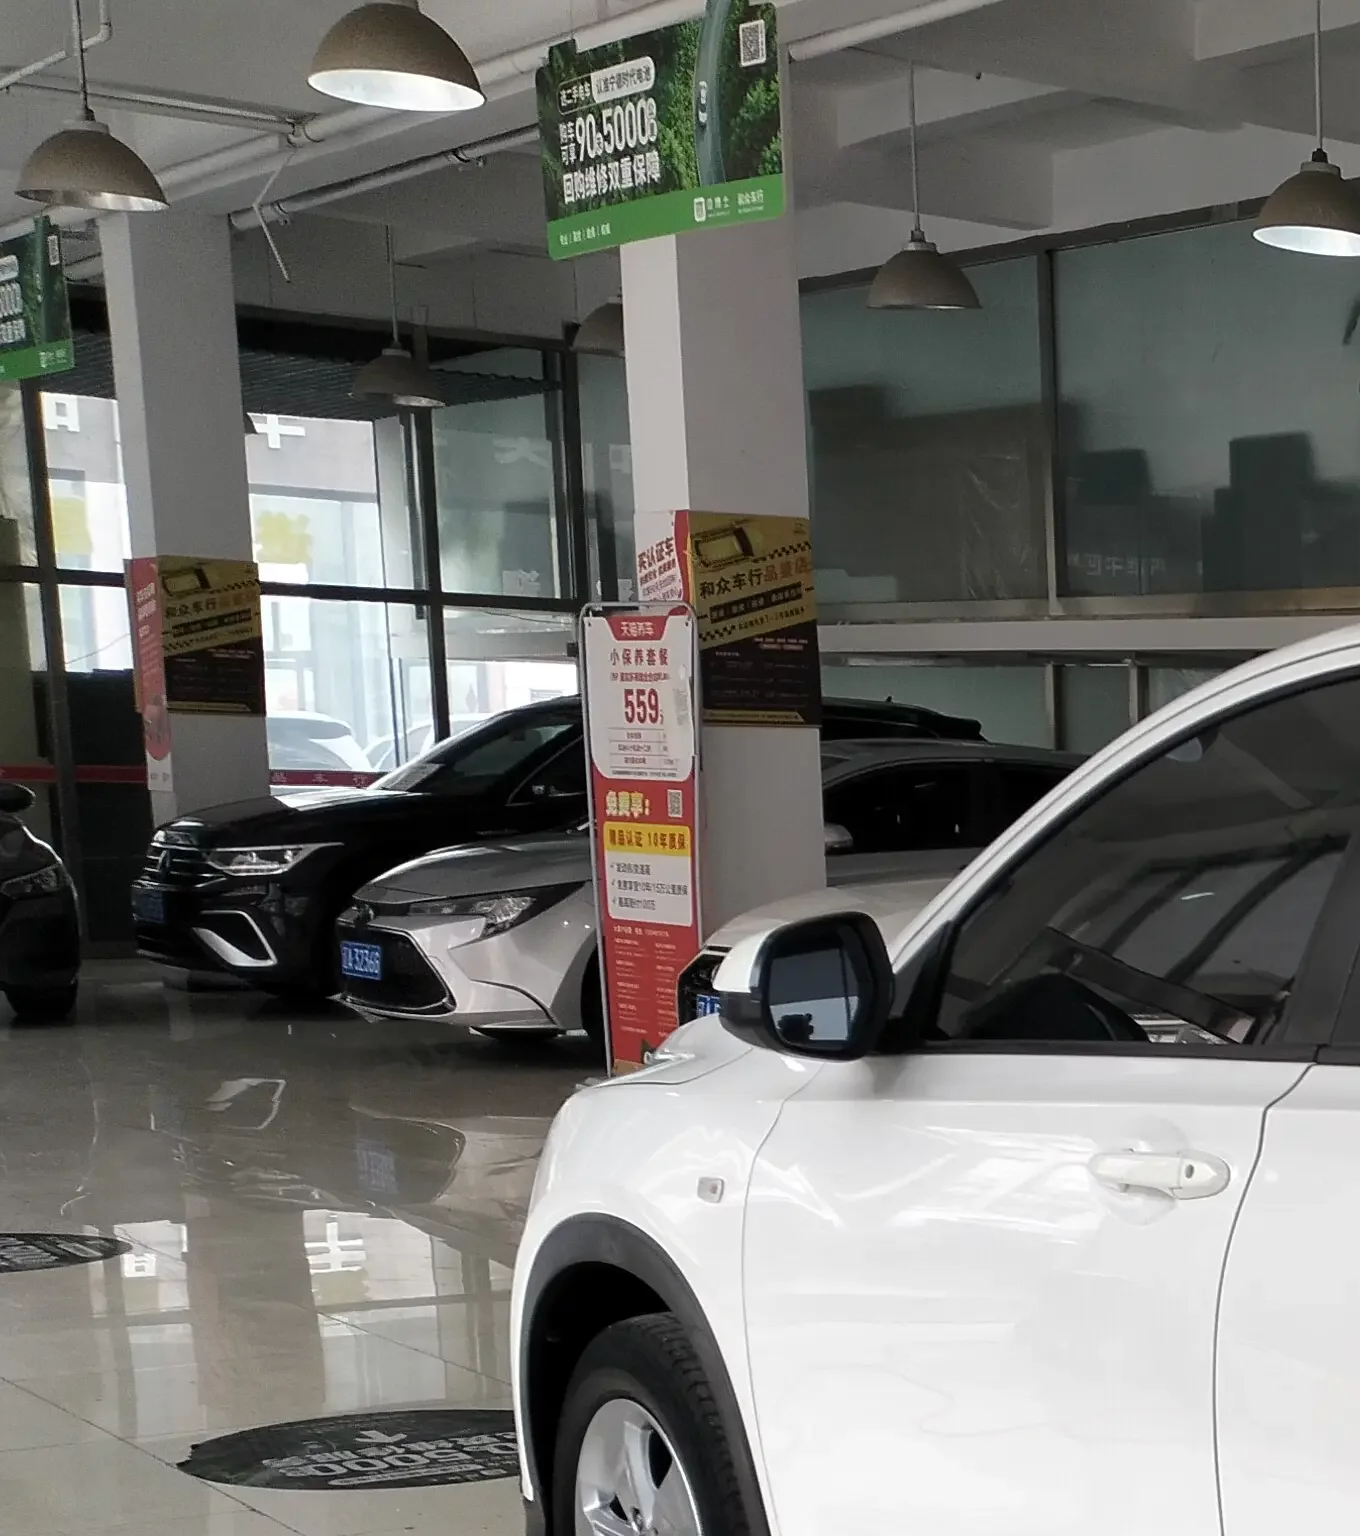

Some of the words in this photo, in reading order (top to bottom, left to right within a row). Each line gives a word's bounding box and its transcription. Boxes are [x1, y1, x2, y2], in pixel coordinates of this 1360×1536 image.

[609, 648, 669, 667] 小保养套餐
